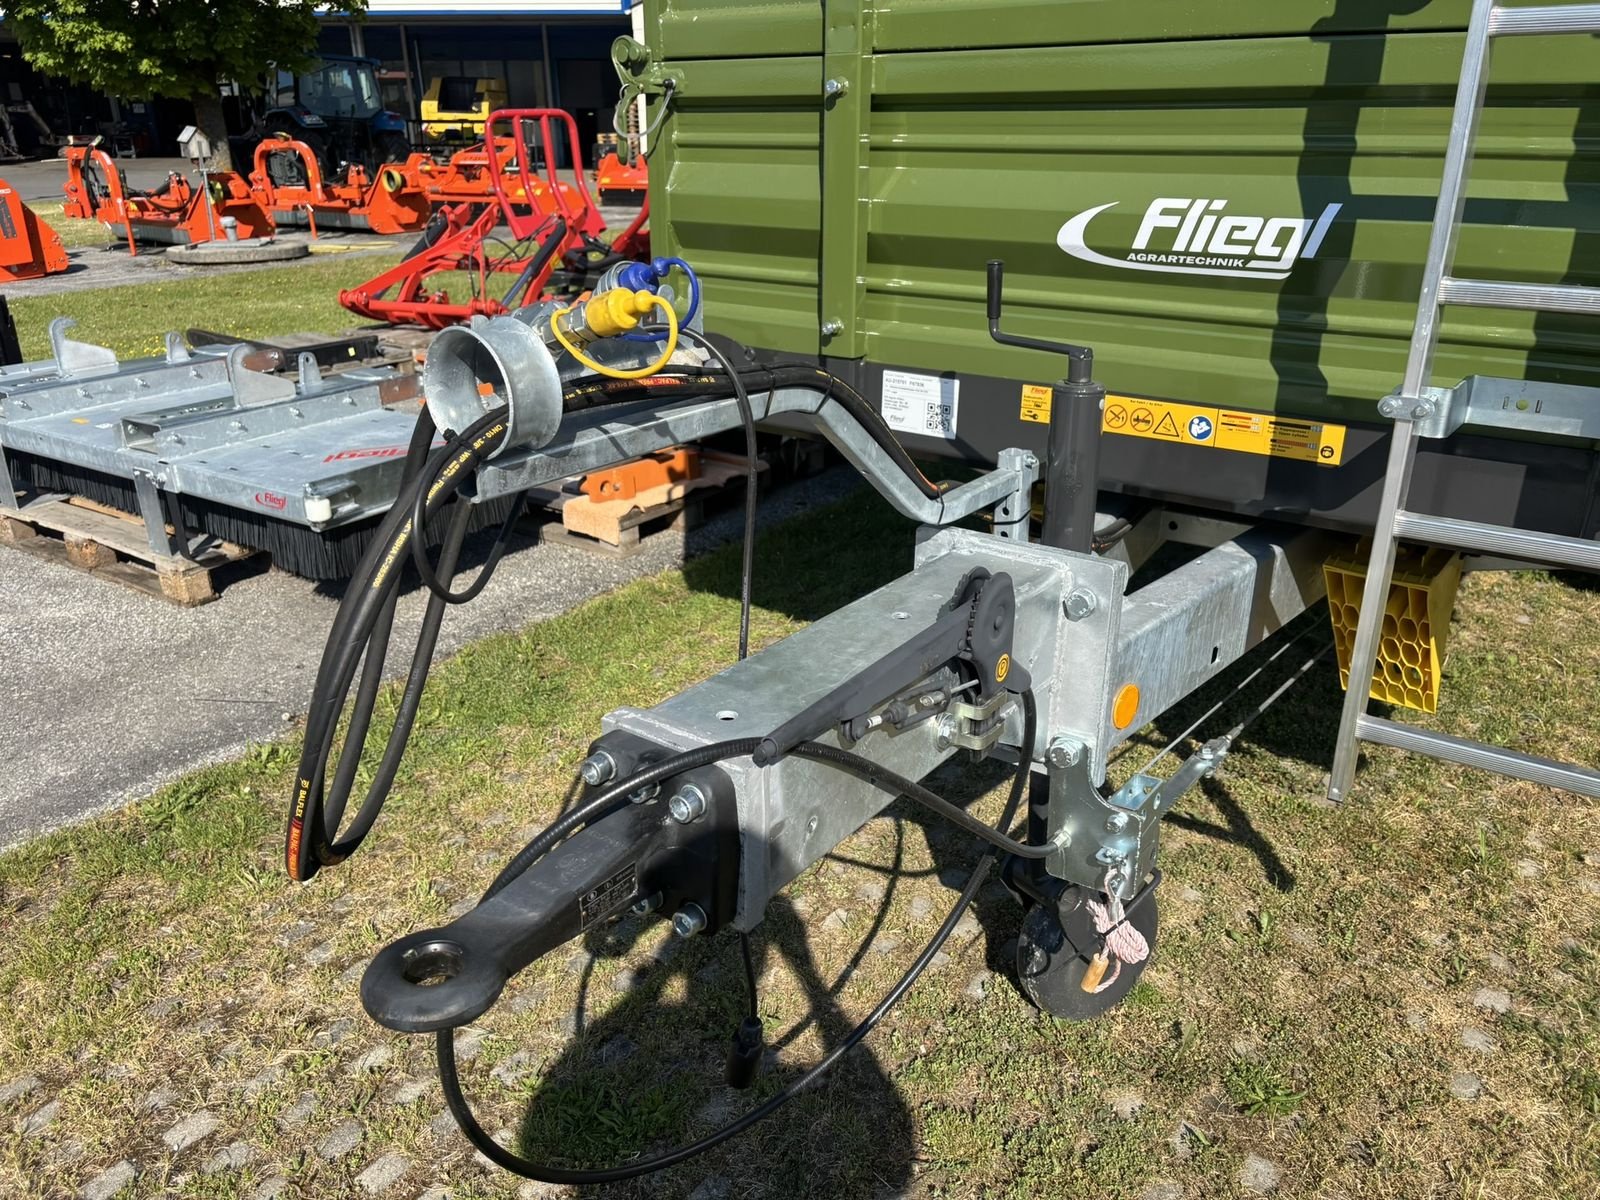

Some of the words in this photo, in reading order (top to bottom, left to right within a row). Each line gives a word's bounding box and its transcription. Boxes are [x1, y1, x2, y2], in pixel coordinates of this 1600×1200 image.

[1131, 197, 1344, 270] Fliegl
[1126, 252, 1246, 268] AGRARTECHNIK
[264, 492, 287, 509] Fliegl
[296, 789, 307, 817] BALFLEX
